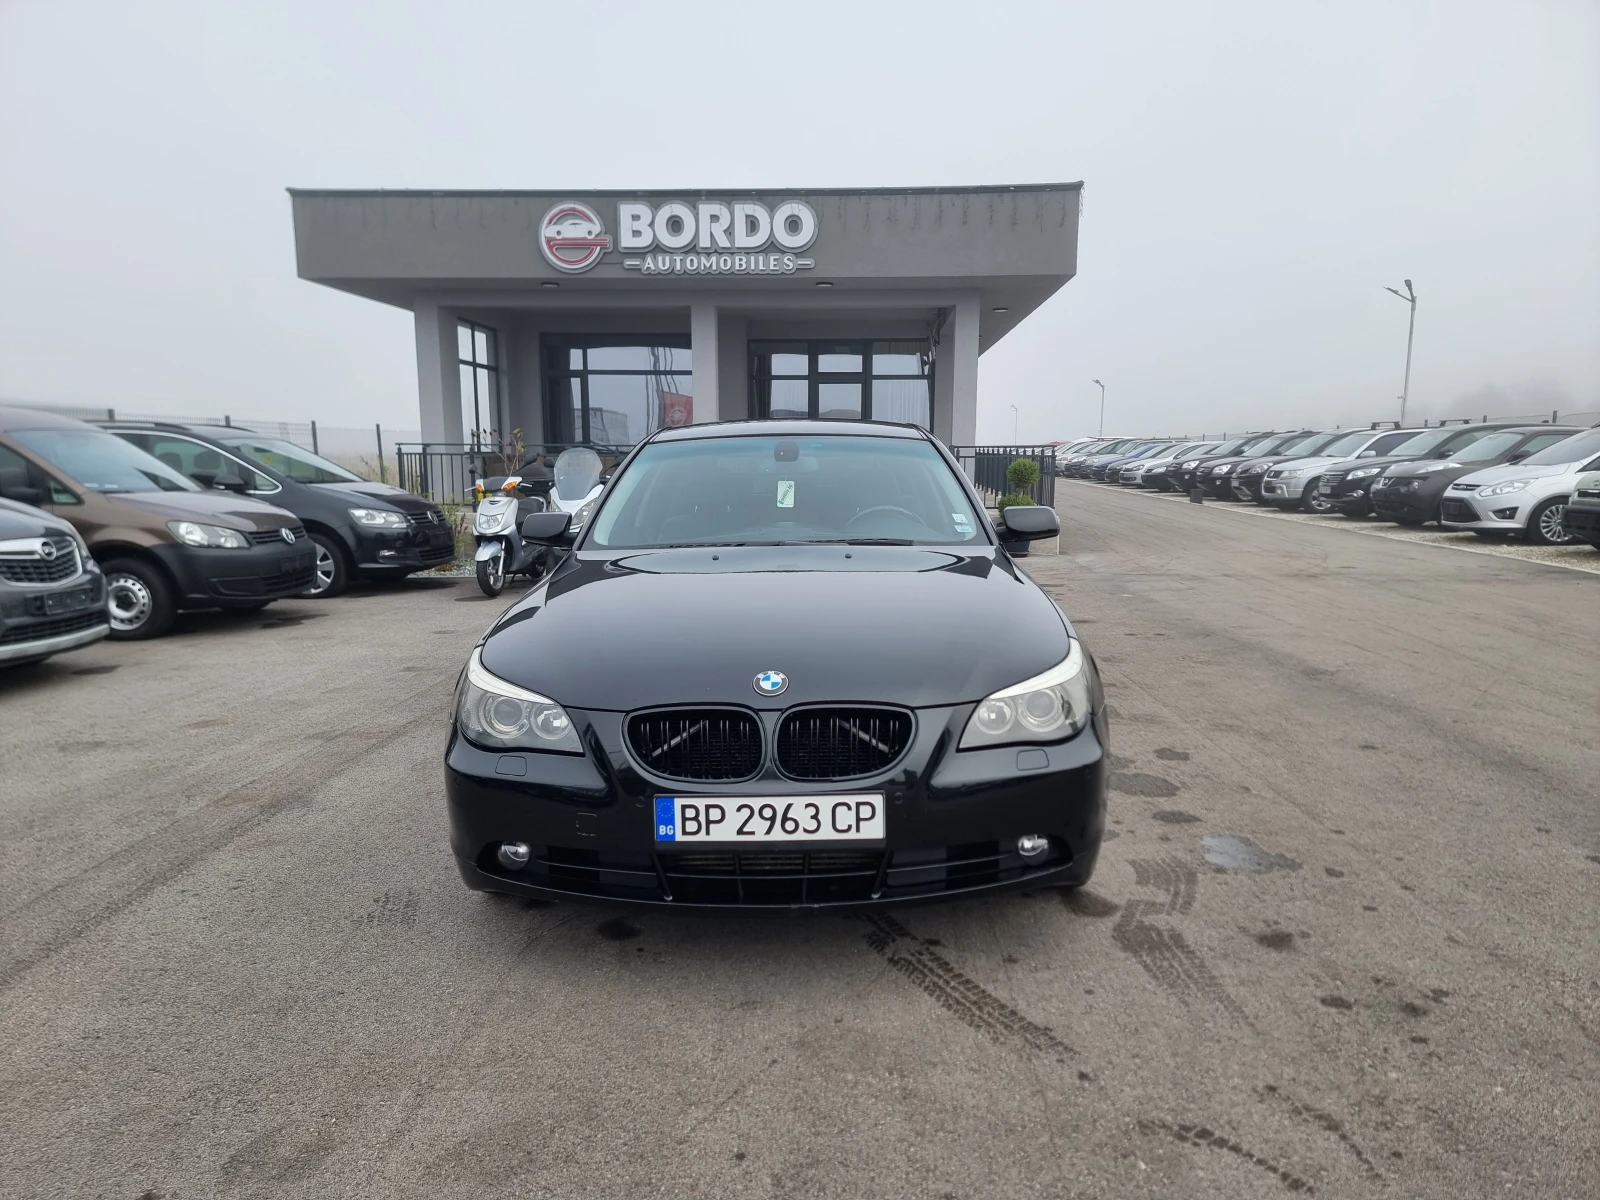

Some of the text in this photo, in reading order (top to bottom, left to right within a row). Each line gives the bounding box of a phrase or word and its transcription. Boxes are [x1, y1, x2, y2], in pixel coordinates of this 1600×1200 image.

[619, 203, 815, 249] BORDO
[757, 671, 786, 679] BMW
[680, 801, 876, 836] BP 2963 CP
[659, 825, 674, 836] BG
